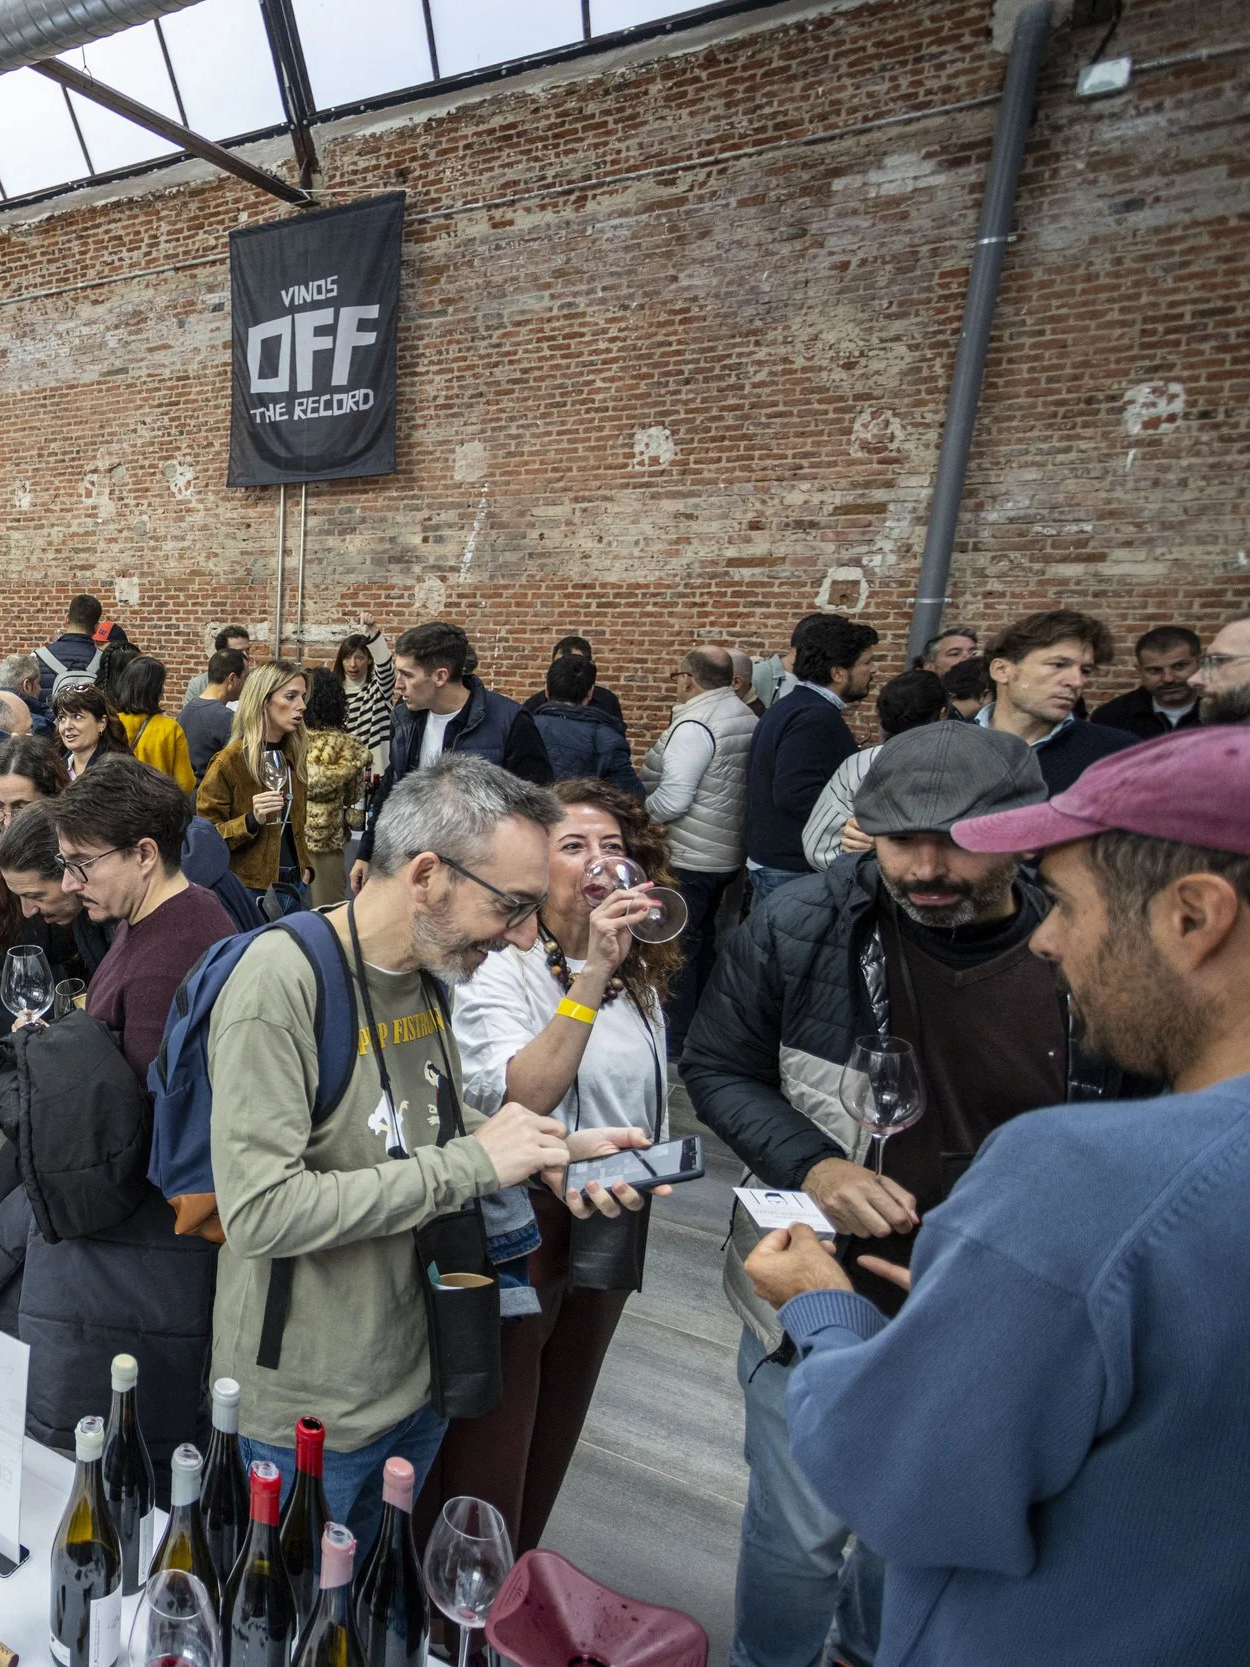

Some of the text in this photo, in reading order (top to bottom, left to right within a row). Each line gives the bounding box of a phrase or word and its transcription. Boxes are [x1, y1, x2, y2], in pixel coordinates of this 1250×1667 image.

[281, 275, 338, 308] VINOS
[247, 304, 380, 393] OFF
[250, 388, 374, 423] THE RECORD
[358, 1022, 389, 1057] PP
